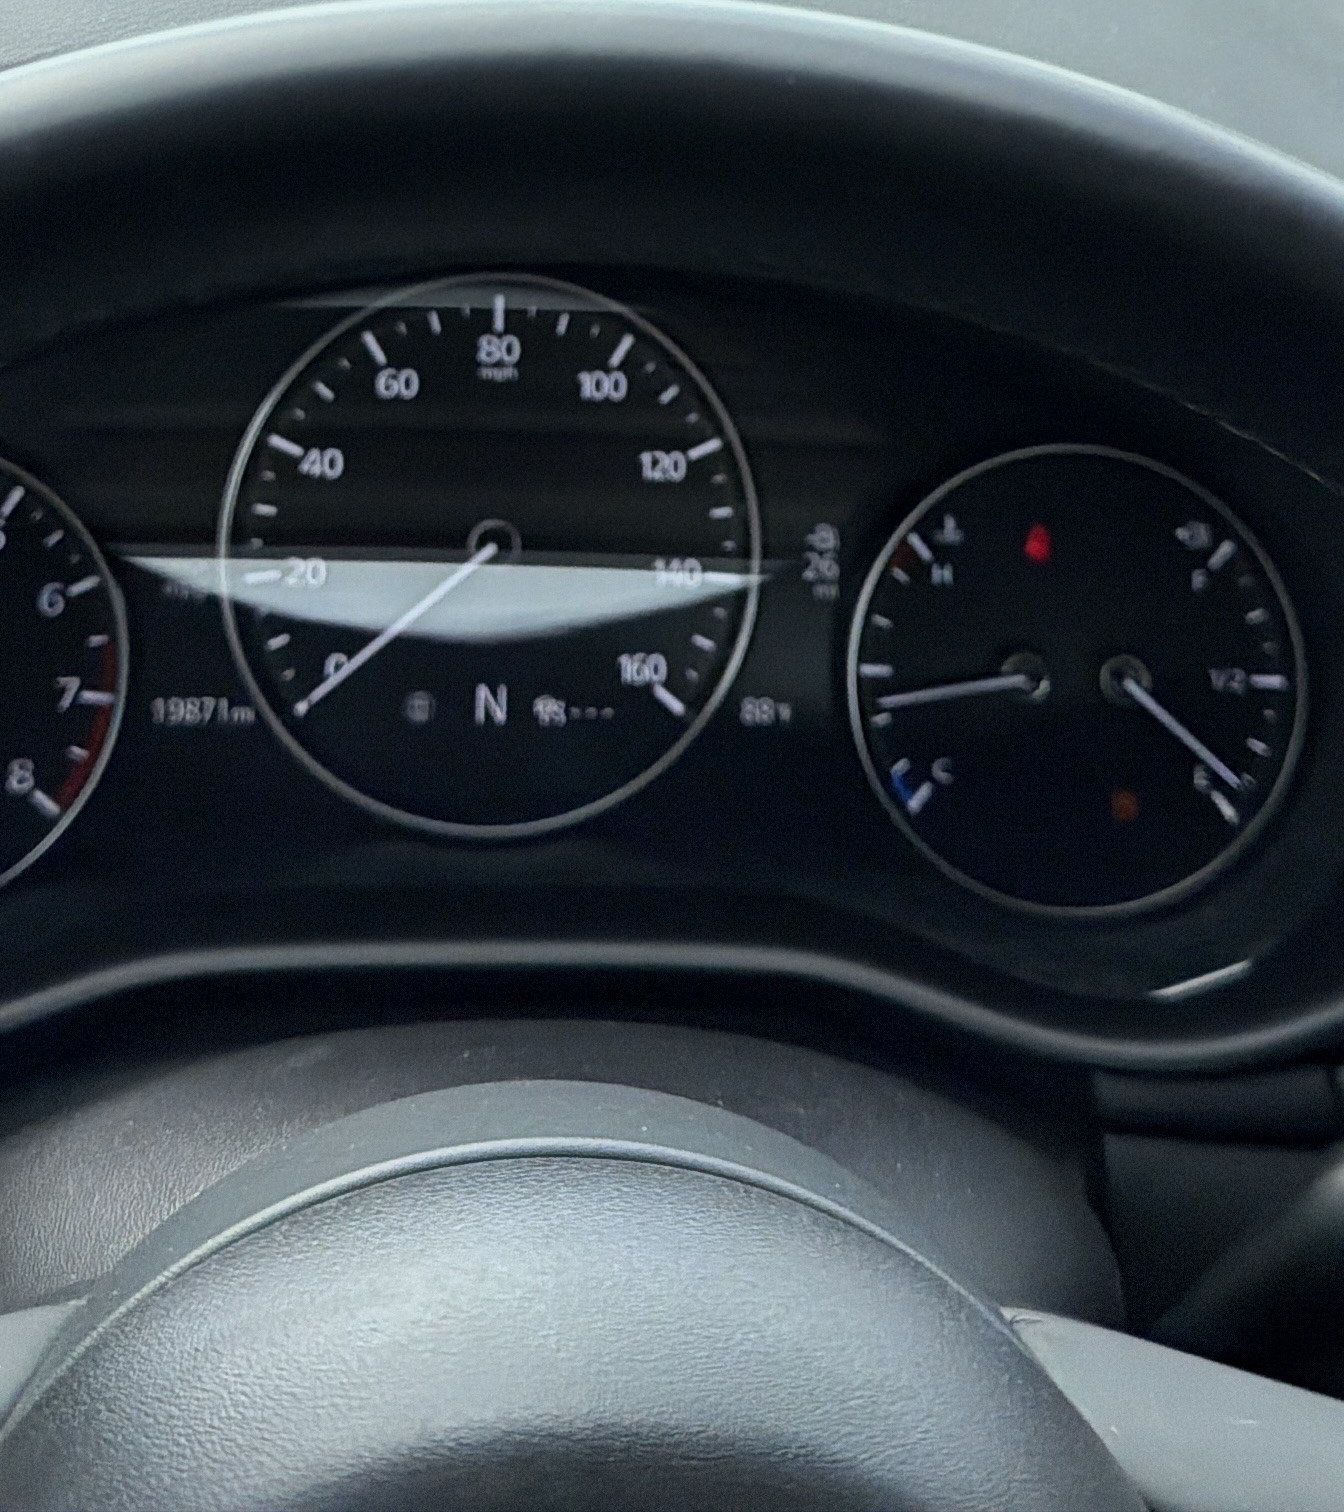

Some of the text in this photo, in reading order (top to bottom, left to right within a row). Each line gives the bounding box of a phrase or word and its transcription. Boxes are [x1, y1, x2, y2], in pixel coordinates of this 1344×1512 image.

[477, 333, 520, 364] 80
[375, 369, 419, 400] 60
[578, 372, 627, 402] 100
[298, 448, 343, 479] 40
[640, 451, 687, 482] 120
[285, 560, 327, 586] 20
[652, 559, 702, 587] 140
[36, 582, 66, 618] 6
[618, 652, 668, 685] 160
[56, 676, 81, 713] 7
[150, 696, 229, 724] 19871
[475, 683, 507, 727] N
[4, 757, 35, 796] 8
